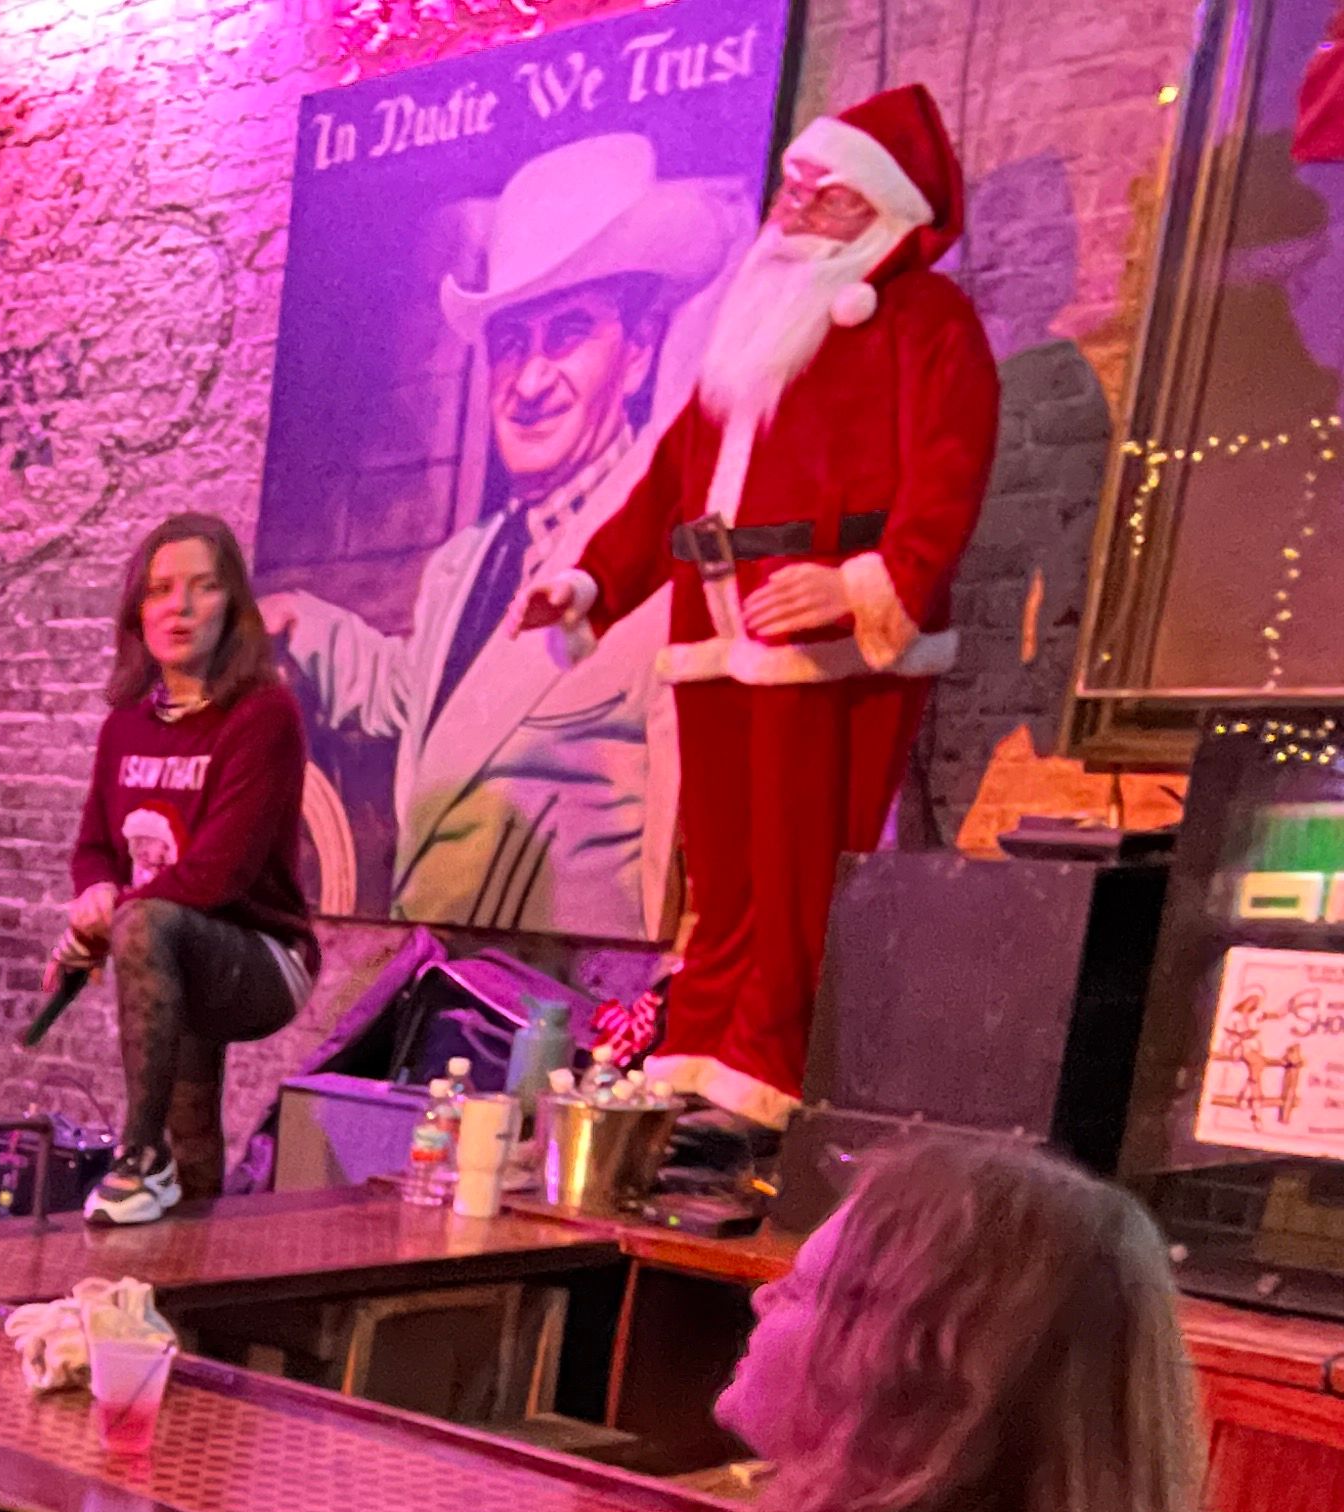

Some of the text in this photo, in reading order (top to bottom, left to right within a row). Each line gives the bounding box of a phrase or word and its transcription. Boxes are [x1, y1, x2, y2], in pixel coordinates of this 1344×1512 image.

[315, 113, 356, 169] In
[519, 52, 605, 119] We
[623, 27, 758, 102] Trust
[161, 755, 211, 790] THAT
